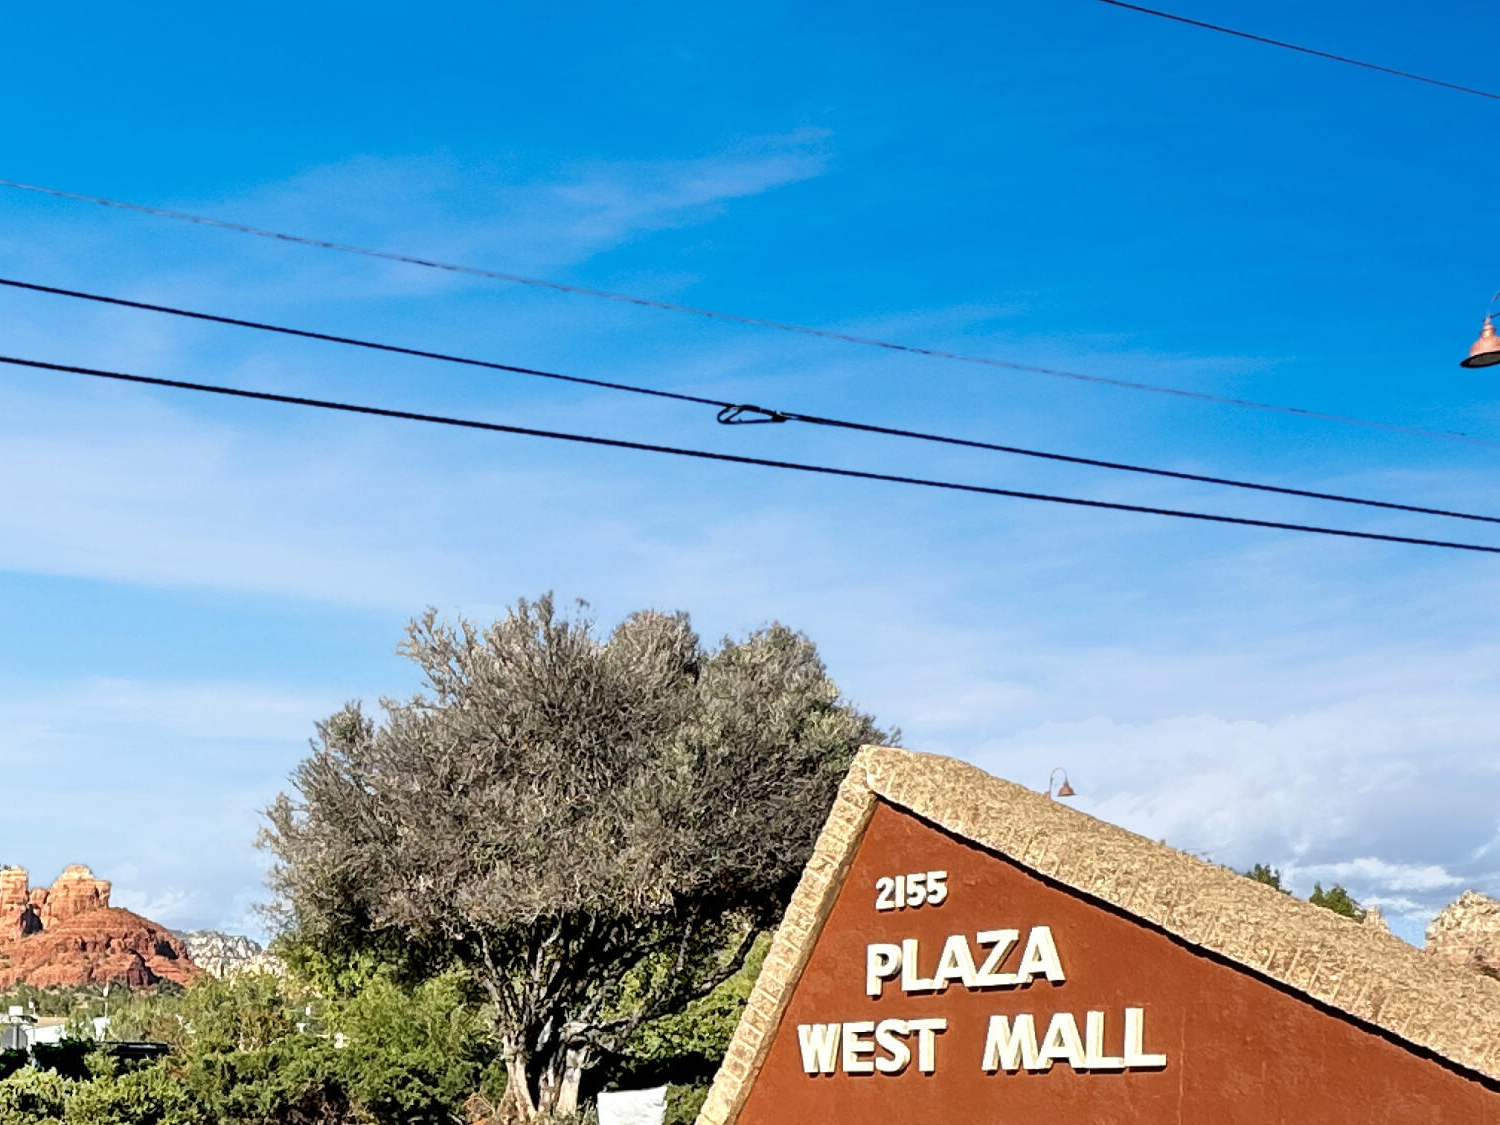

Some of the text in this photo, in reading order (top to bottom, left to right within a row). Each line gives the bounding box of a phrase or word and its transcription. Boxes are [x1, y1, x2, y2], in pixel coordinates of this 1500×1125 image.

[875, 871, 948, 911] 2155
[866, 926, 1065, 996] PLAZA
[798, 1008, 1167, 1074] WEST MALL
